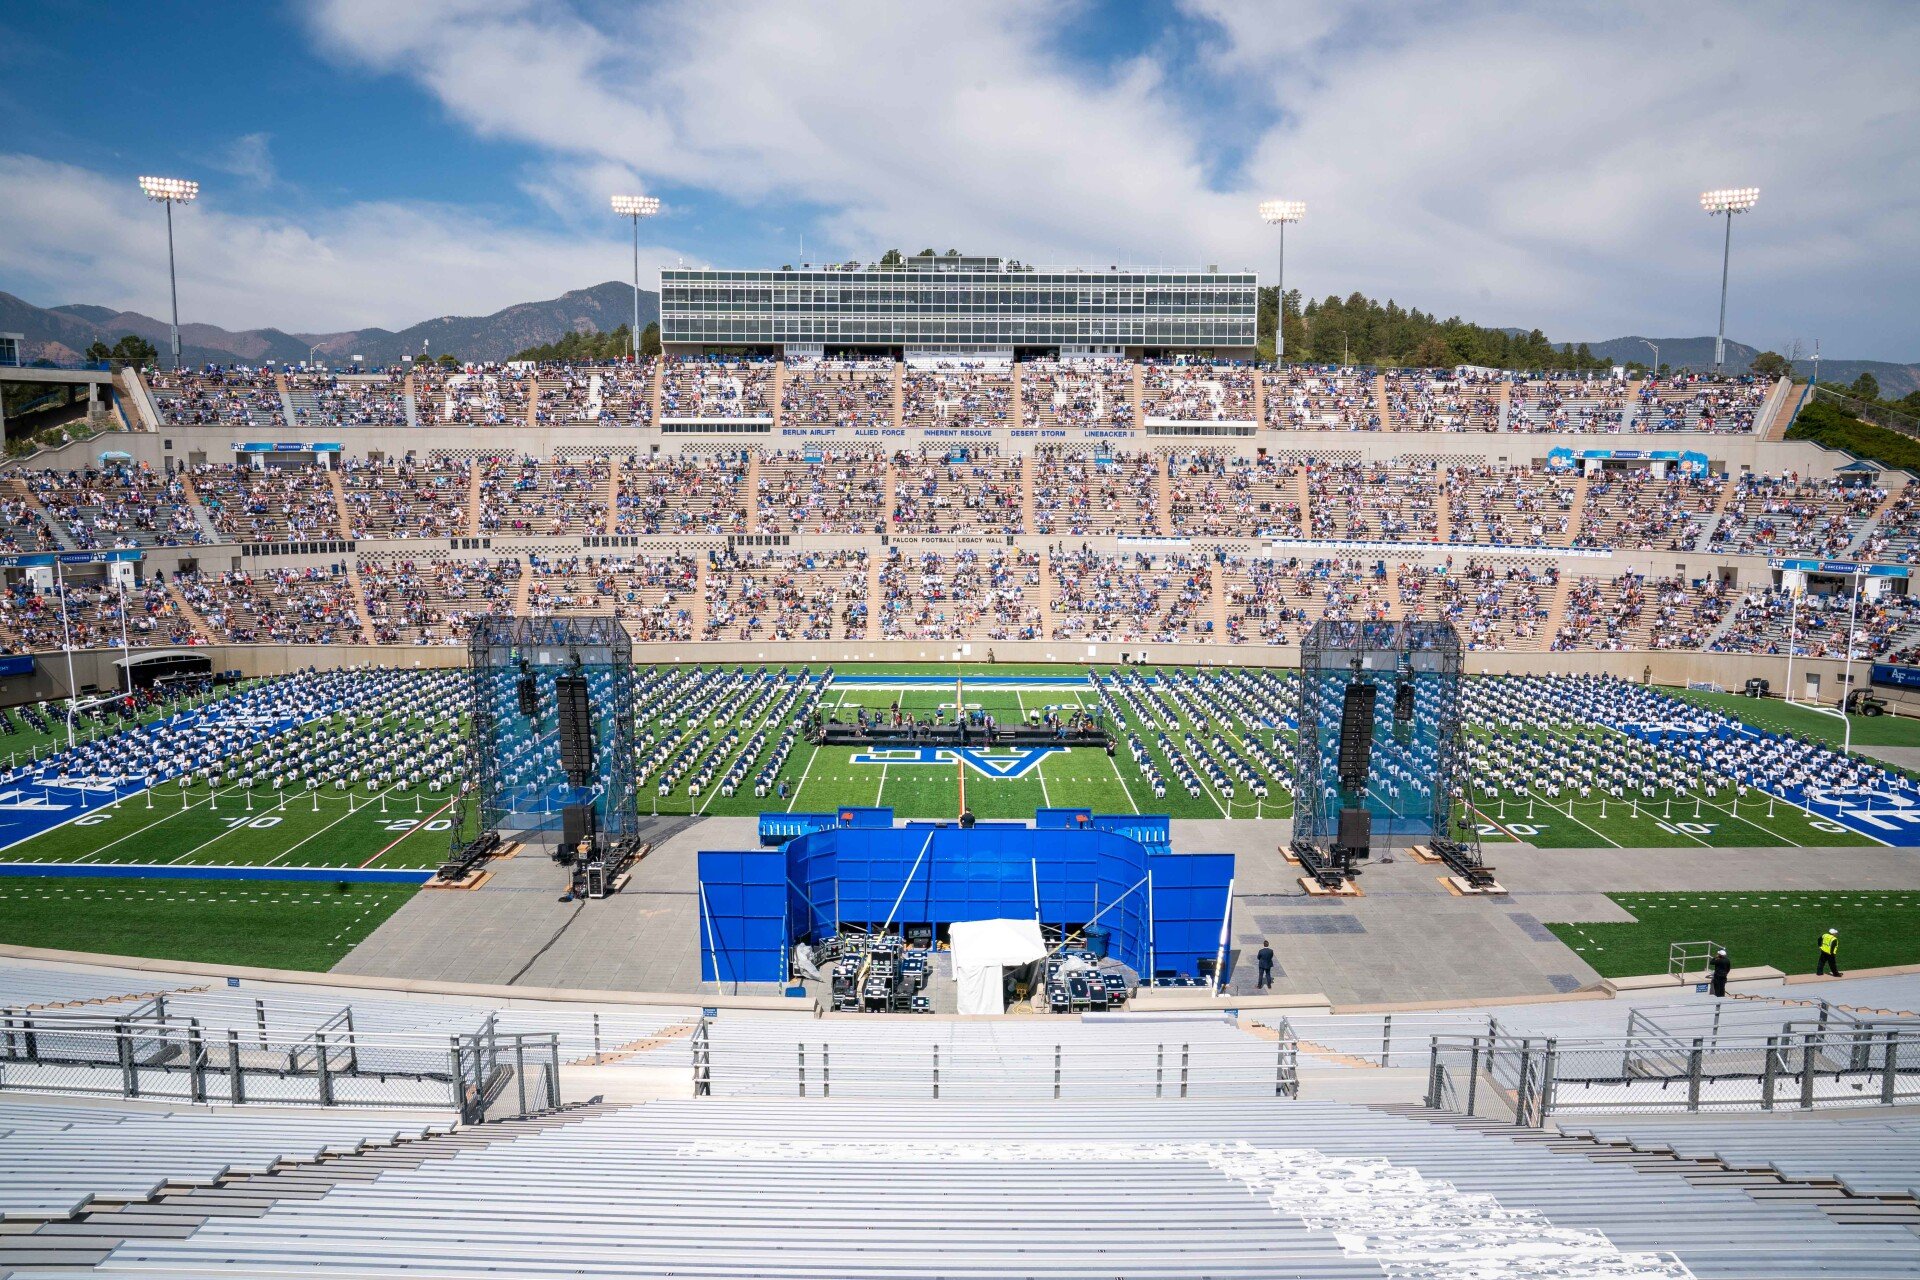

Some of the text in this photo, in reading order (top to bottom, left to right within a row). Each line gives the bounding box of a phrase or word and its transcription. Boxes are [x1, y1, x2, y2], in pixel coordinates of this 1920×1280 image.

[1891, 669, 1905, 683] AF
[228, 816, 283, 828] 10
[384, 819, 453, 831] 20
[1655, 822, 1712, 834] 10
[1809, 822, 1848, 833] G
[1477, 823, 1539, 835] 20
